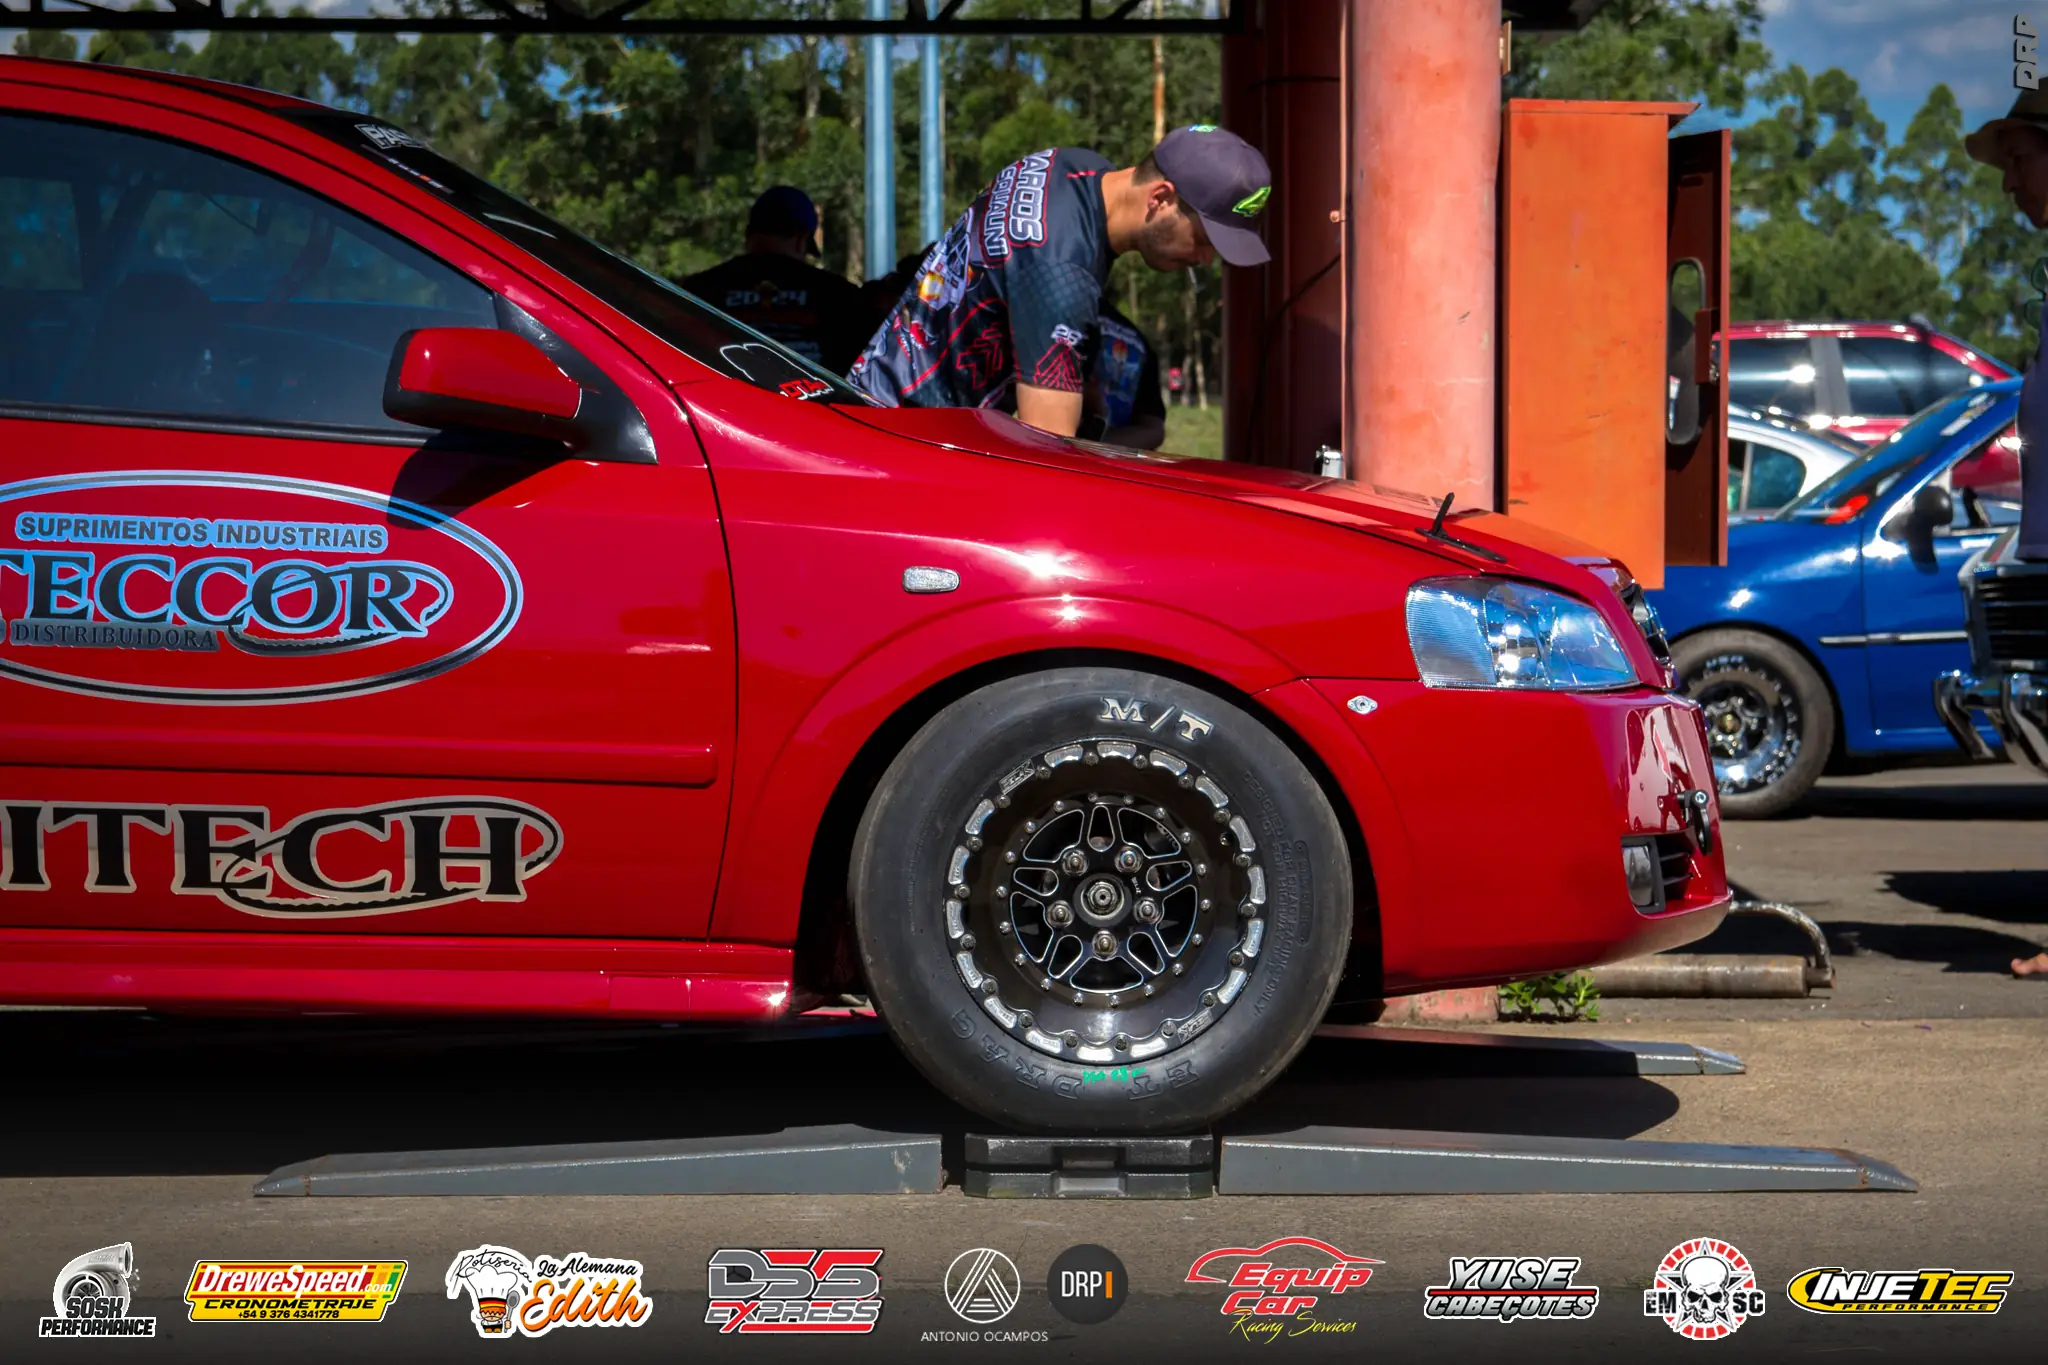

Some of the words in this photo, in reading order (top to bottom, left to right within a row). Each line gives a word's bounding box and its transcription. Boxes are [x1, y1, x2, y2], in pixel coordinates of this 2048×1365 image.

[20, 516, 208, 542] SUPRIMENTOS
[216, 523, 384, 549] INDUSTRIAIS
[14, 624, 218, 650] DISTRIBUIDORA
[1100, 697, 1214, 743] M/T
